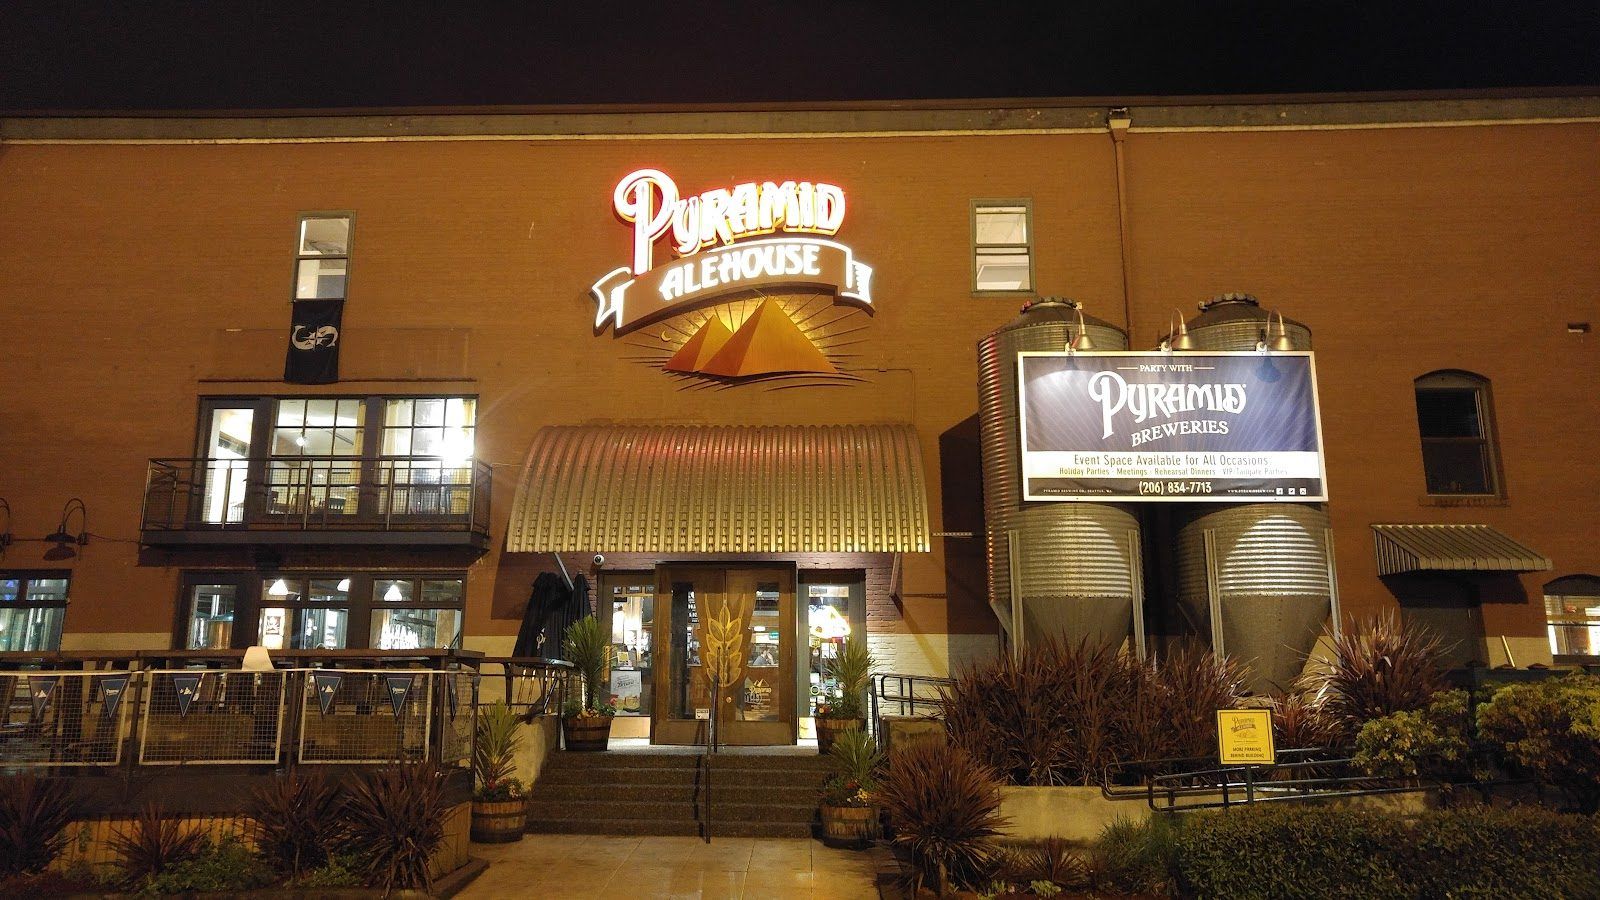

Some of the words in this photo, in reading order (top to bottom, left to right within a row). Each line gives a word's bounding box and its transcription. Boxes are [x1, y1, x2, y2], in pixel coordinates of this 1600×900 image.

[613, 168, 846, 275] PYRAMID
[659, 244, 821, 300] ALEHOUSE
[1139, 364, 1168, 372] PARTY
[1169, 364, 1193, 372] WITH
[1087, 370, 1247, 440] PYRAMID
[1131, 420, 1229, 447] BREWERIES
[1074, 454, 1100, 465] Event
[1103, 454, 1133, 467] Space
[1136, 454, 1181, 466] Available
[1185, 454, 1199, 466] for
[1203, 454, 1217, 466] All
[1219, 454, 1269, 466] Occasions
[1059, 467, 1084, 476] Holiday
[1086, 467, 1110, 475] Parties
[1116, 467, 1148, 476] Meetings
[1154, 467, 1188, 475] Rehearsal
[1190, 467, 1216, 475] Dinners
[1139, 481, 1164, 495] (206)
[1167, 481, 1212, 493] 834-7713
